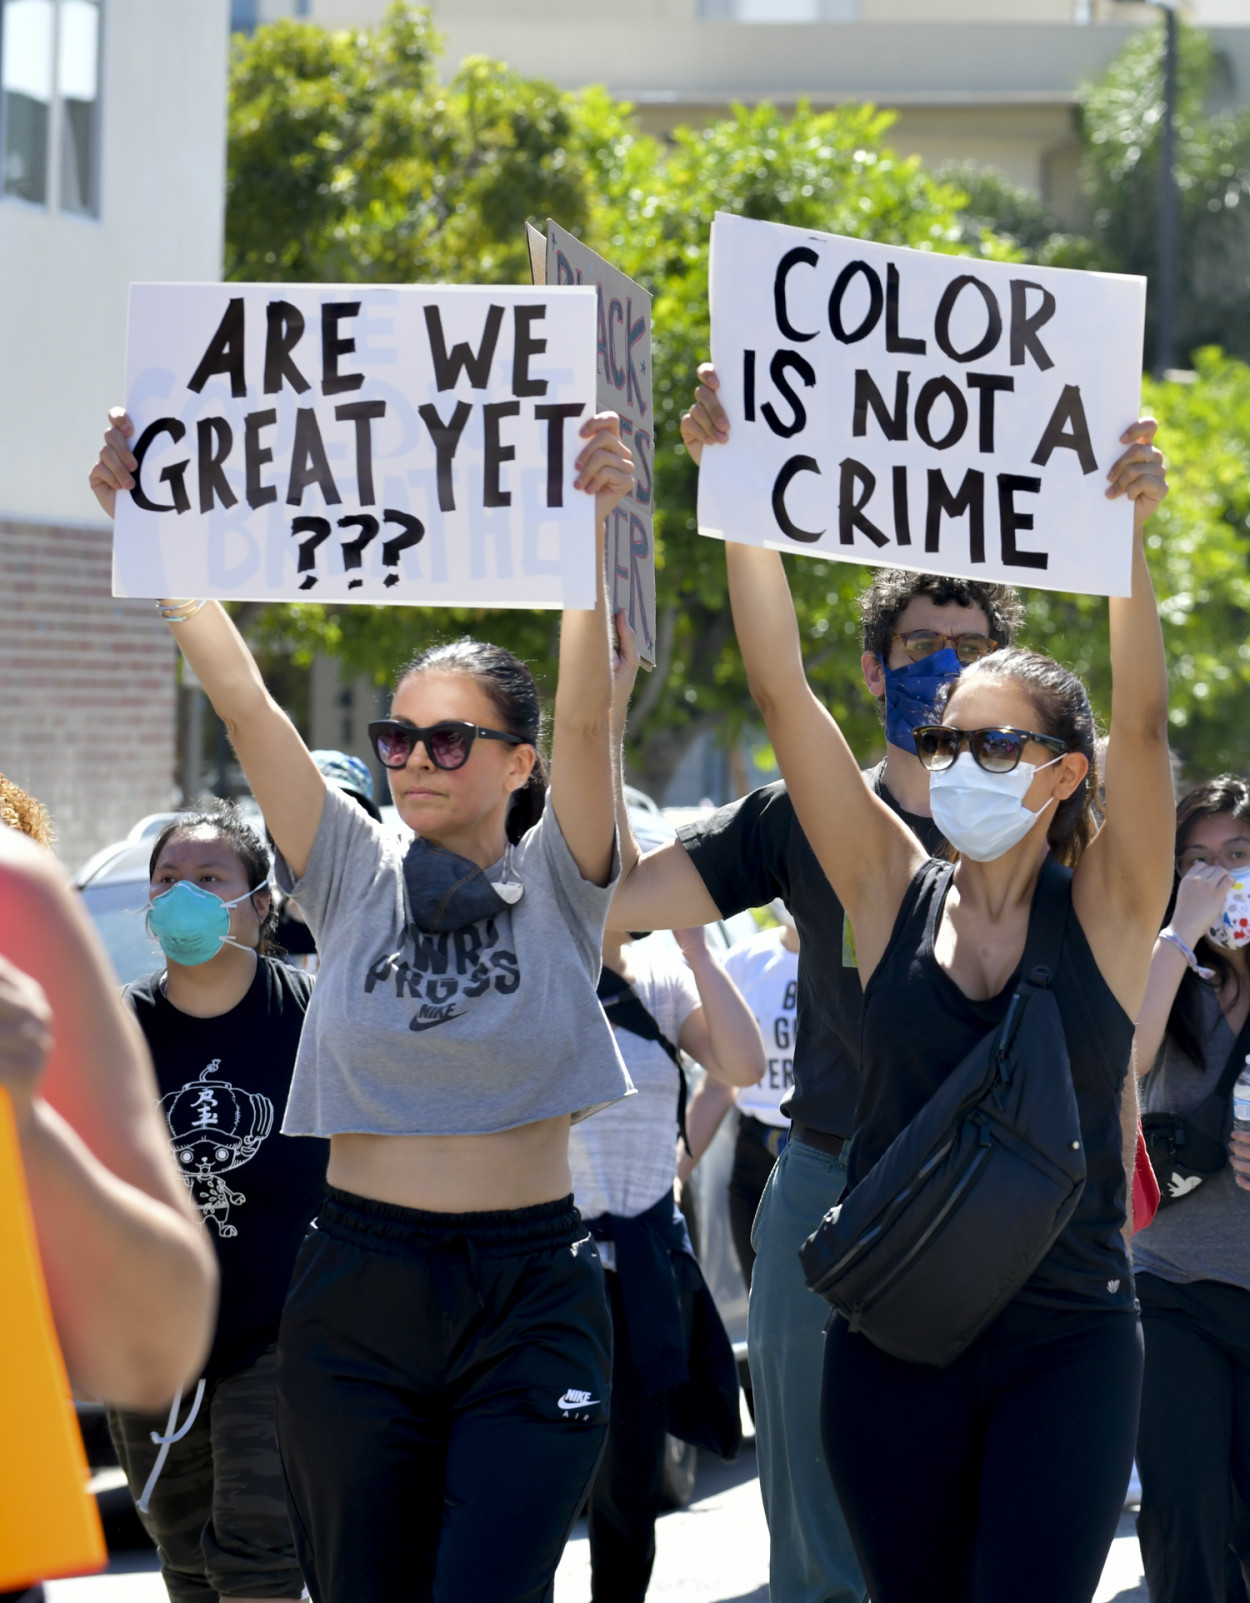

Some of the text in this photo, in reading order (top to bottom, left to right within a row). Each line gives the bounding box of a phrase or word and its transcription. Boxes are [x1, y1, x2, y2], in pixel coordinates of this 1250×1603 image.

[187, 298, 548, 399] ARE WE
[774, 246, 1057, 372] COLOR
[130, 400, 387, 515] GREAT
[418, 400, 586, 512] YET
[743, 349, 1099, 476] IS NOT A
[291, 508, 426, 590] ???
[771, 454, 1049, 570] CRIME
[418, 1002, 457, 1019] NIKE
[563, 1410, 590, 1422] AIR
[564, 1388, 592, 1403] NIKE
